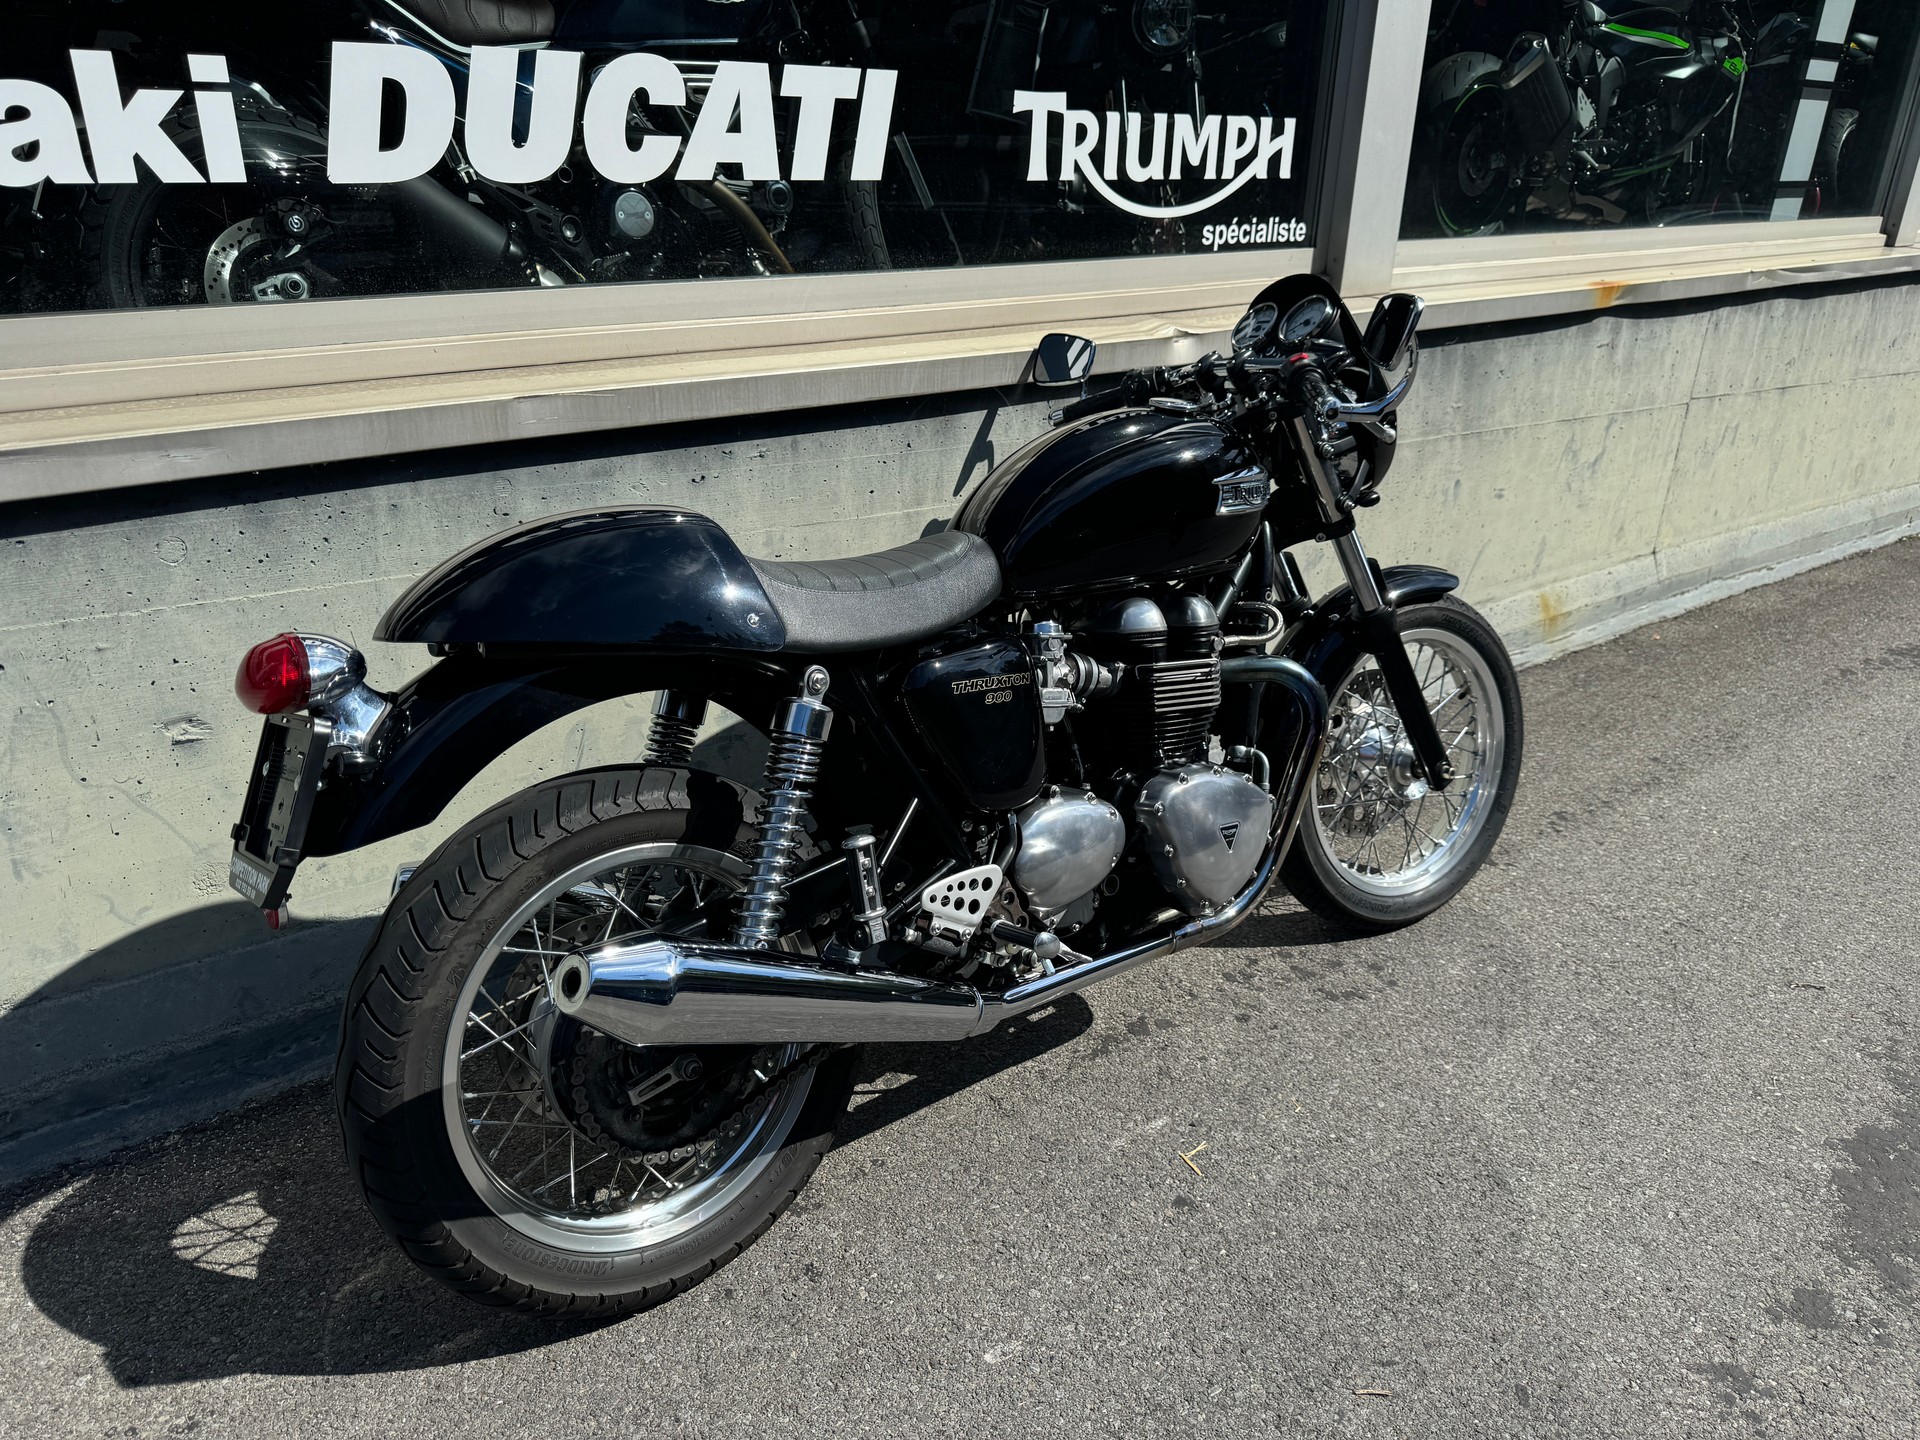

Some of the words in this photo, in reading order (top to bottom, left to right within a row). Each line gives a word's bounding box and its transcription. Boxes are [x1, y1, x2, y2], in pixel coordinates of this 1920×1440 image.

[327, 41, 898, 184] DUCATI
[1012, 90, 1297, 218] TRIUMPH
[1202, 217, 1307, 251] spécialiste
[952, 672, 1030, 694] THRUXTON
[985, 690, 1013, 704] 900
[503, 1239, 609, 1277] BRIDGESTONE
